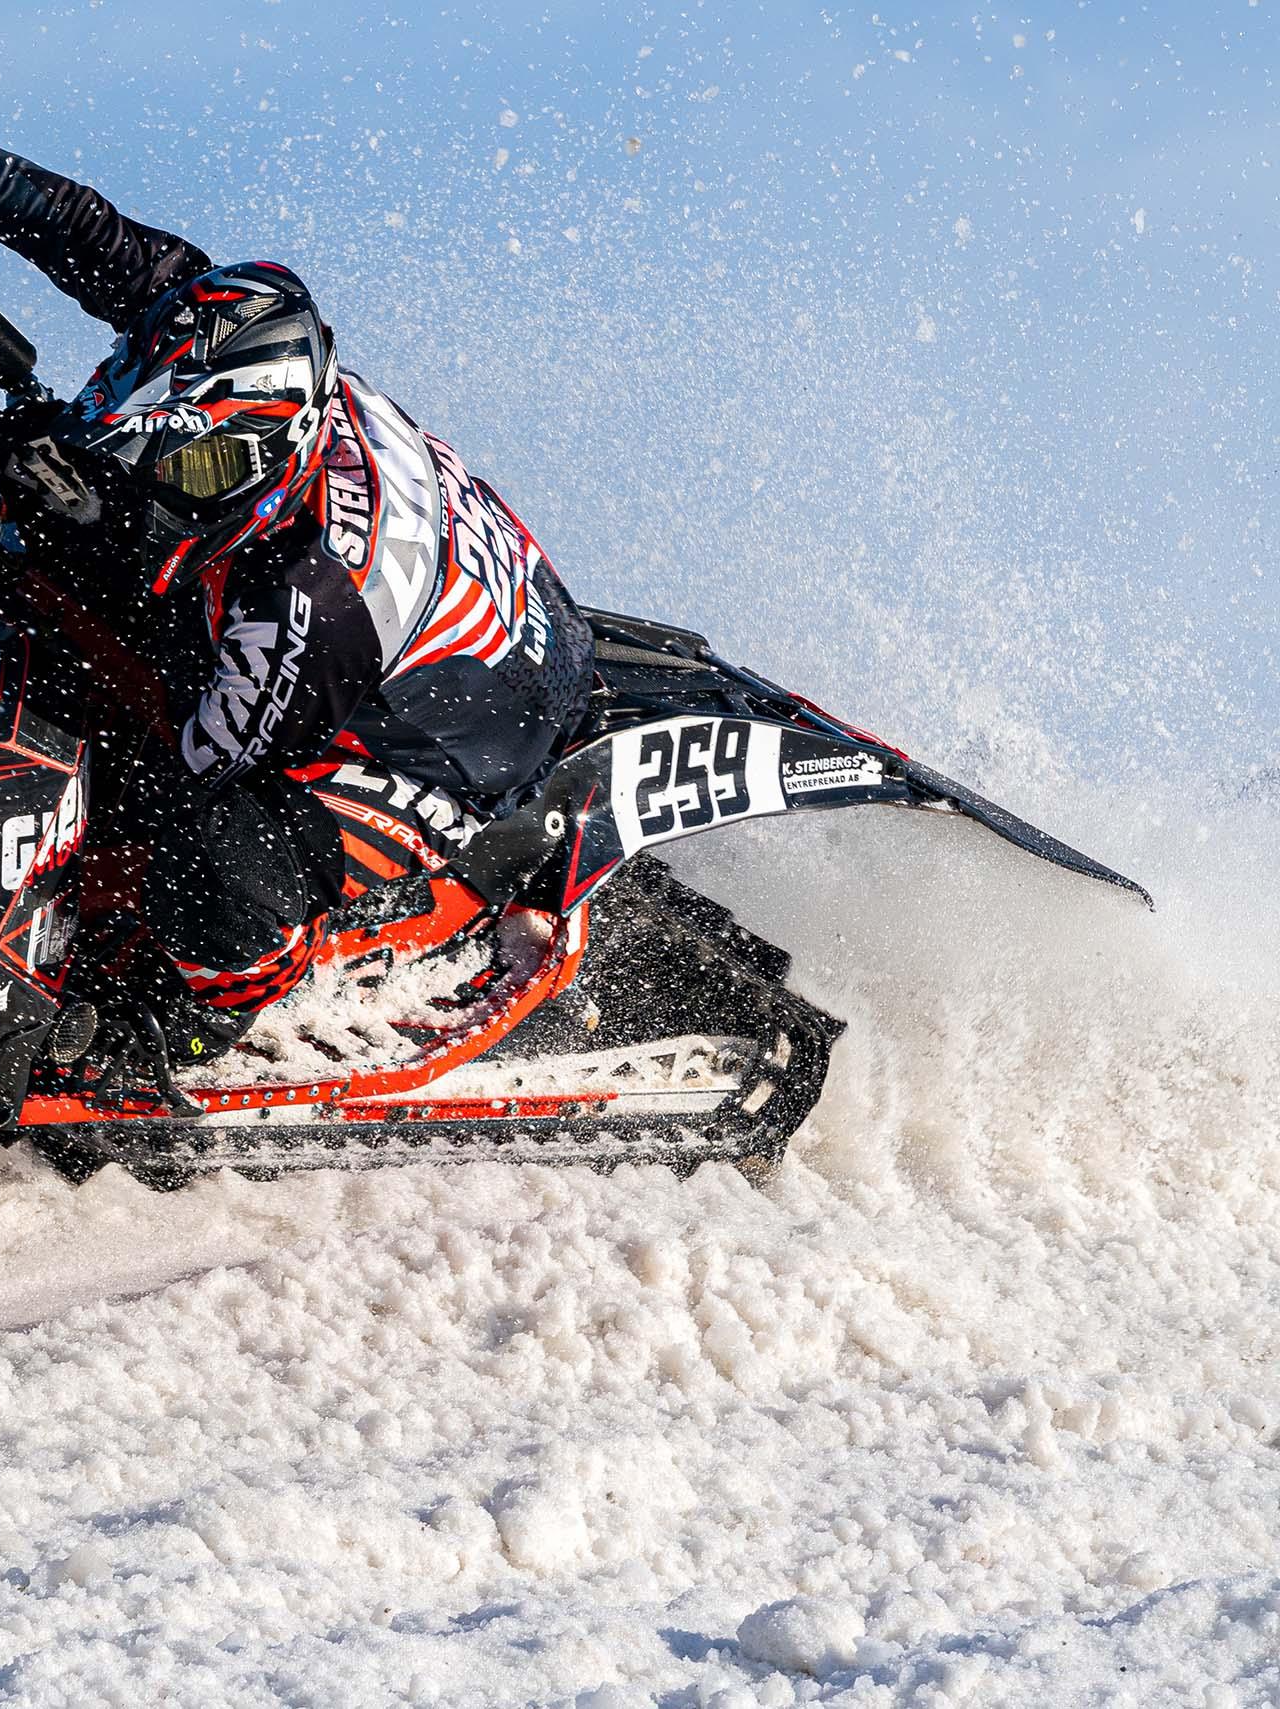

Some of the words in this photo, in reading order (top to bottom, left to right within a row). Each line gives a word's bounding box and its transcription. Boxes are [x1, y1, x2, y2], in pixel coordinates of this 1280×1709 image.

[120, 408, 205, 433] Airoh
[439, 470, 453, 540] ROTAX
[163, 555, 180, 581] Airoh
[240, 585, 312, 766] RACING
[635, 719, 751, 836] 259
[795, 754, 860, 775] STENBERGS
[786, 774, 846, 790] ENTREPRENAD
[848, 773, 860, 783] AB
